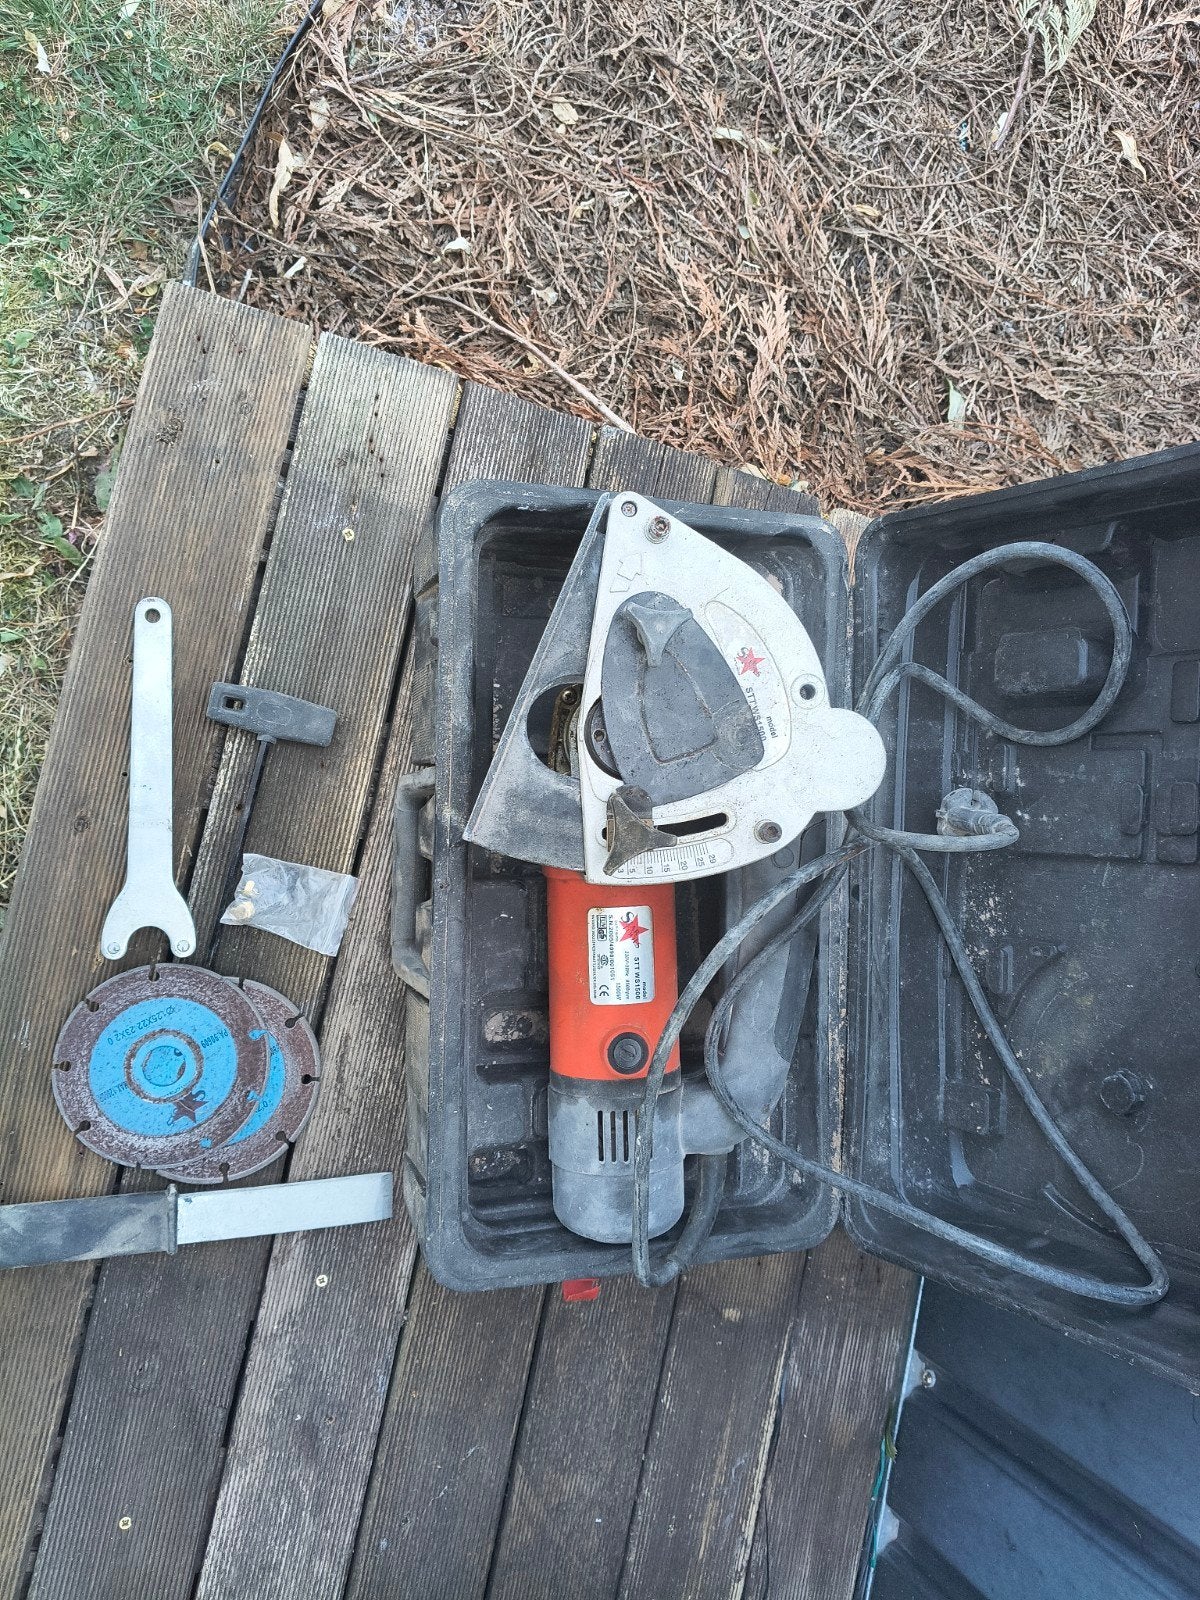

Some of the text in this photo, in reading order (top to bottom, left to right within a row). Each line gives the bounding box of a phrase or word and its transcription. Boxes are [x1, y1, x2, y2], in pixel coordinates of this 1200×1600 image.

[766, 716, 778, 739] model
[646, 866, 653, 874] 10
[663, 863, 670, 872] 15
[680, 860, 688, 870] 20
[697, 856, 705, 866] 25
